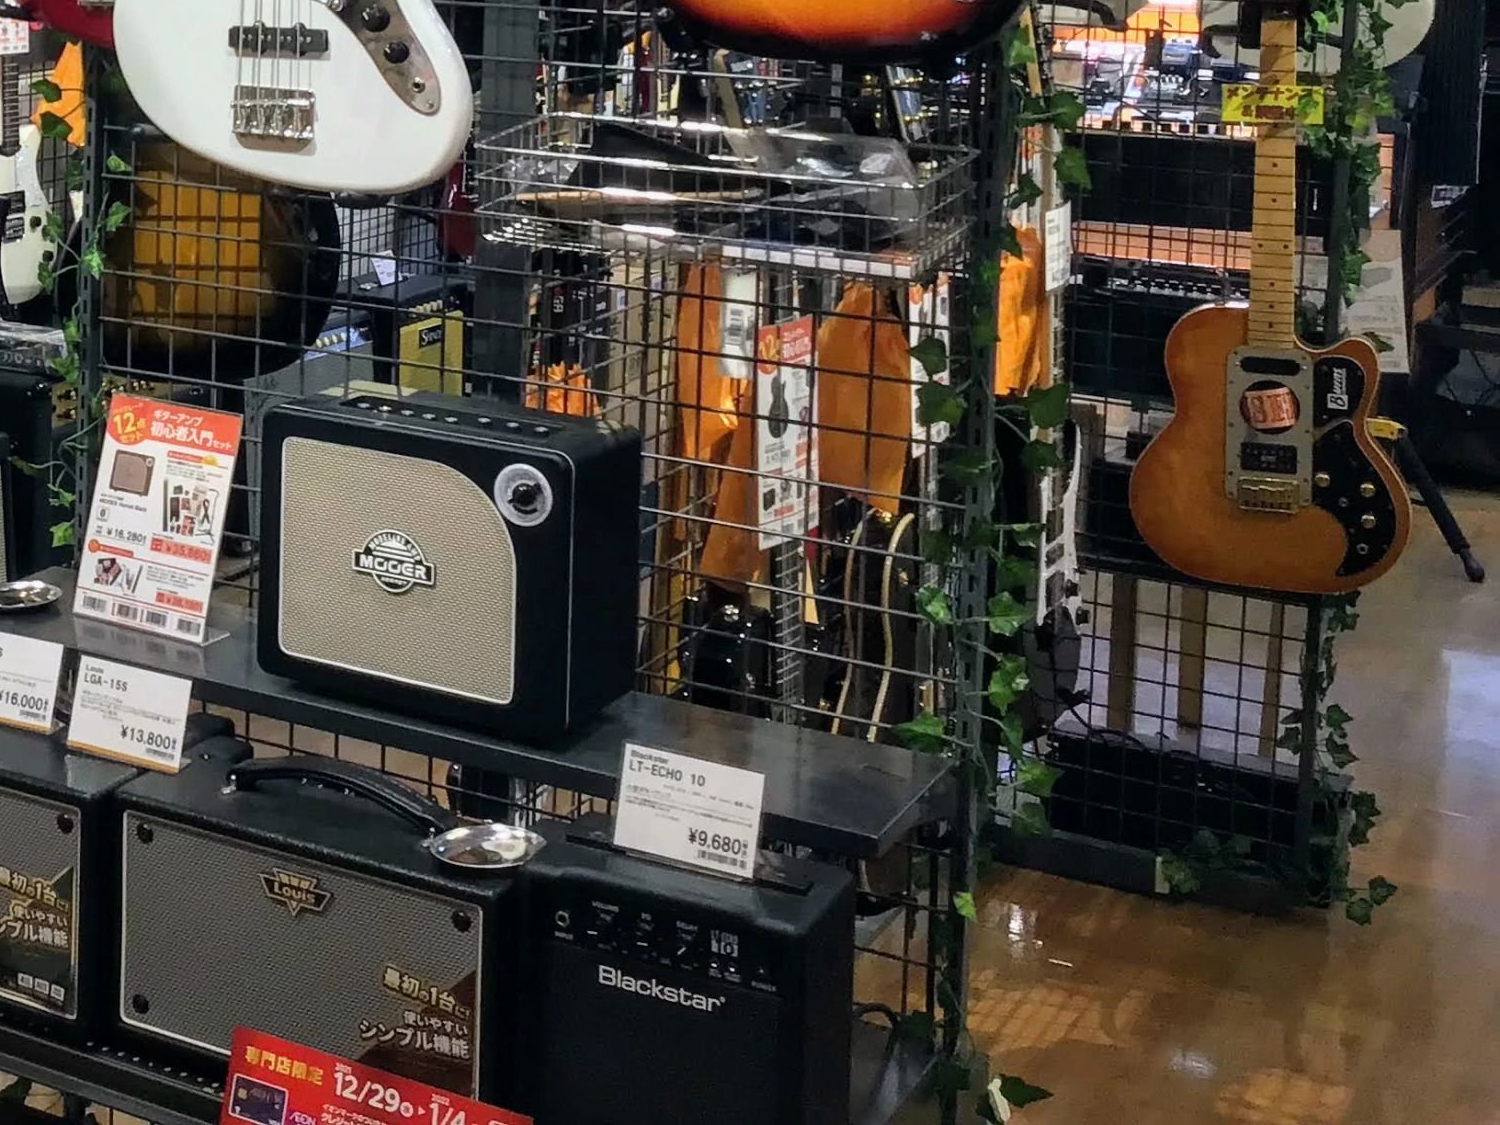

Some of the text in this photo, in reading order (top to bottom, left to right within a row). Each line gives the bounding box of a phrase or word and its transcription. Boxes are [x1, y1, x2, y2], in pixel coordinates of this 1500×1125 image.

[112, 411, 148, 435] 12点
[152, 408, 204, 427] ギターアンプ
[119, 429, 146, 444] セット
[150, 421, 233, 451] 初心者入門セット
[359, 553, 428, 580] MOOER
[84, 672, 129, 693] LGA-15S
[121, 724, 172, 751] ¥13,800
[629, 749, 670, 765] Blackstar
[628, 760, 706, 787] LT-ECHO 10
[687, 827, 742, 856] ¥9,680
[273, 881, 316, 904] Louis
[13, 905, 68, 927] 使いやすい
[597, 964, 722, 1013] Blackstar
[403, 1009, 469, 1037] 使いやすい
[358, 1018, 471, 1059] シンプル機能
[244, 1044, 325, 1086] 専門店限定
[333, 1071, 401, 1114] 12/29
[429, 1102, 467, 1125] 1/4
